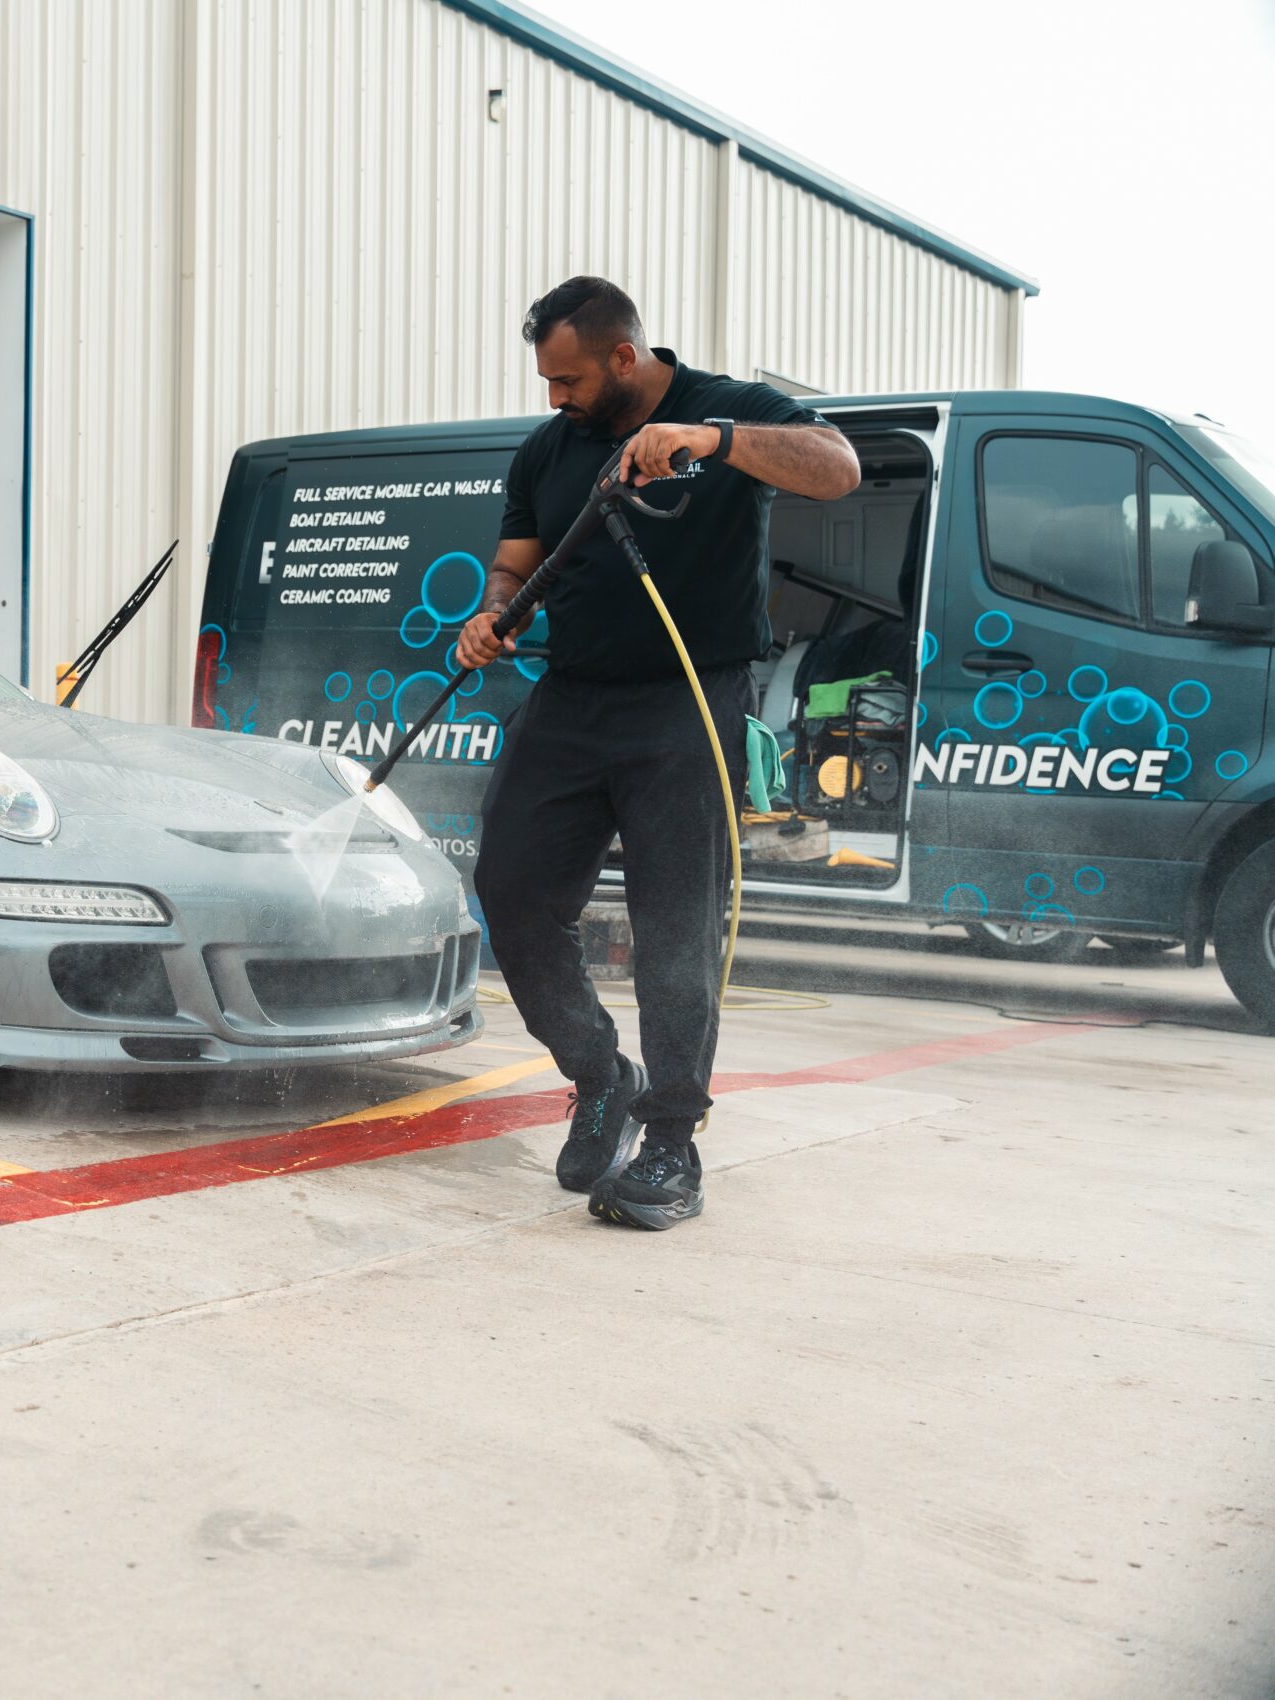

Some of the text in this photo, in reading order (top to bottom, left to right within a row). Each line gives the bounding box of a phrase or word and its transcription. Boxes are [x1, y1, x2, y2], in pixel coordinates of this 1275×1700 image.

[293, 478, 503, 502] FULL SERVICE MOBILE CAR WASH &
[289, 510, 386, 527] BOAT DETAILING
[285, 535, 410, 552] AIRCRAFT DETAILING
[282, 561, 399, 578] PAINT CORRECTION
[280, 588, 391, 604] CERAMIC COATING
[278, 718, 497, 760] CLEAN WITH
[913, 742, 1171, 792] NFIDENCE
